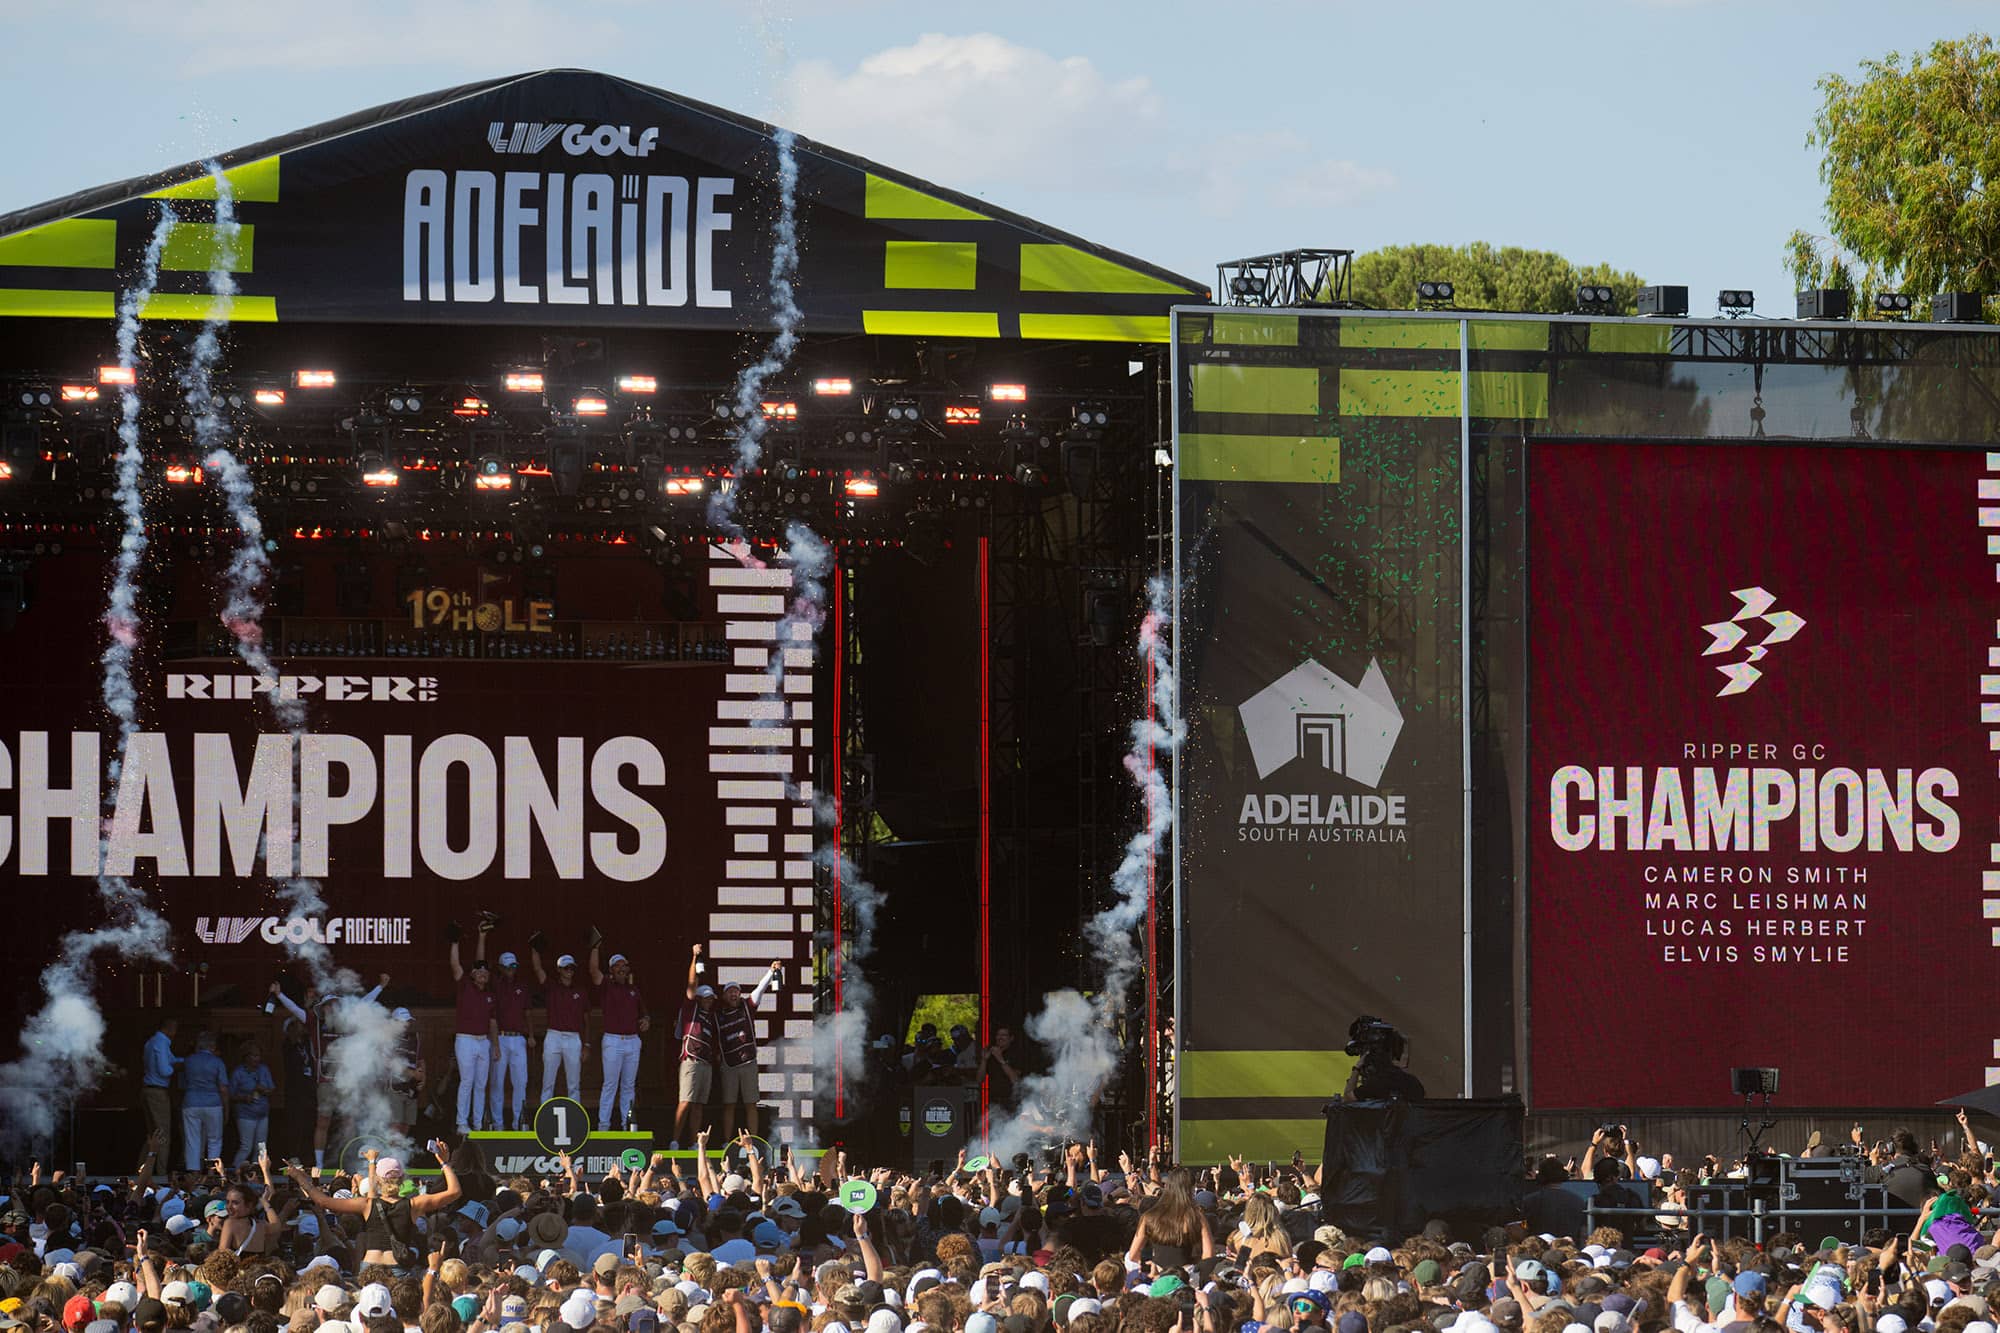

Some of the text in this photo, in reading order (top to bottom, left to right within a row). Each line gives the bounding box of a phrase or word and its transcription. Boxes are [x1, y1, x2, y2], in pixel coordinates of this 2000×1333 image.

[403, 169, 734, 308] ADELAIDE
[406, 588, 472, 629] 19th
[166, 673, 416, 701] RIPPER
[1684, 743, 1826, 760] RIPPER GC
[0, 730, 668, 881] HAMPIONS
[1238, 794, 1407, 825] ADELAIDE
[1549, 765, 1961, 853] CHAMPIONS
[1238, 827, 1407, 842] SOUTH AUSTRALIA
[1644, 866, 1867, 884] CAMERON SMITH
[1645, 893, 1867, 910] MARC LEISHMAN
[345, 917, 411, 944] ADELAIDE
[1646, 919, 1867, 936] LUCAS HERBERT
[1664, 946, 1849, 962] ELVIS SMYLIE
[552, 1106, 572, 1146] 1
